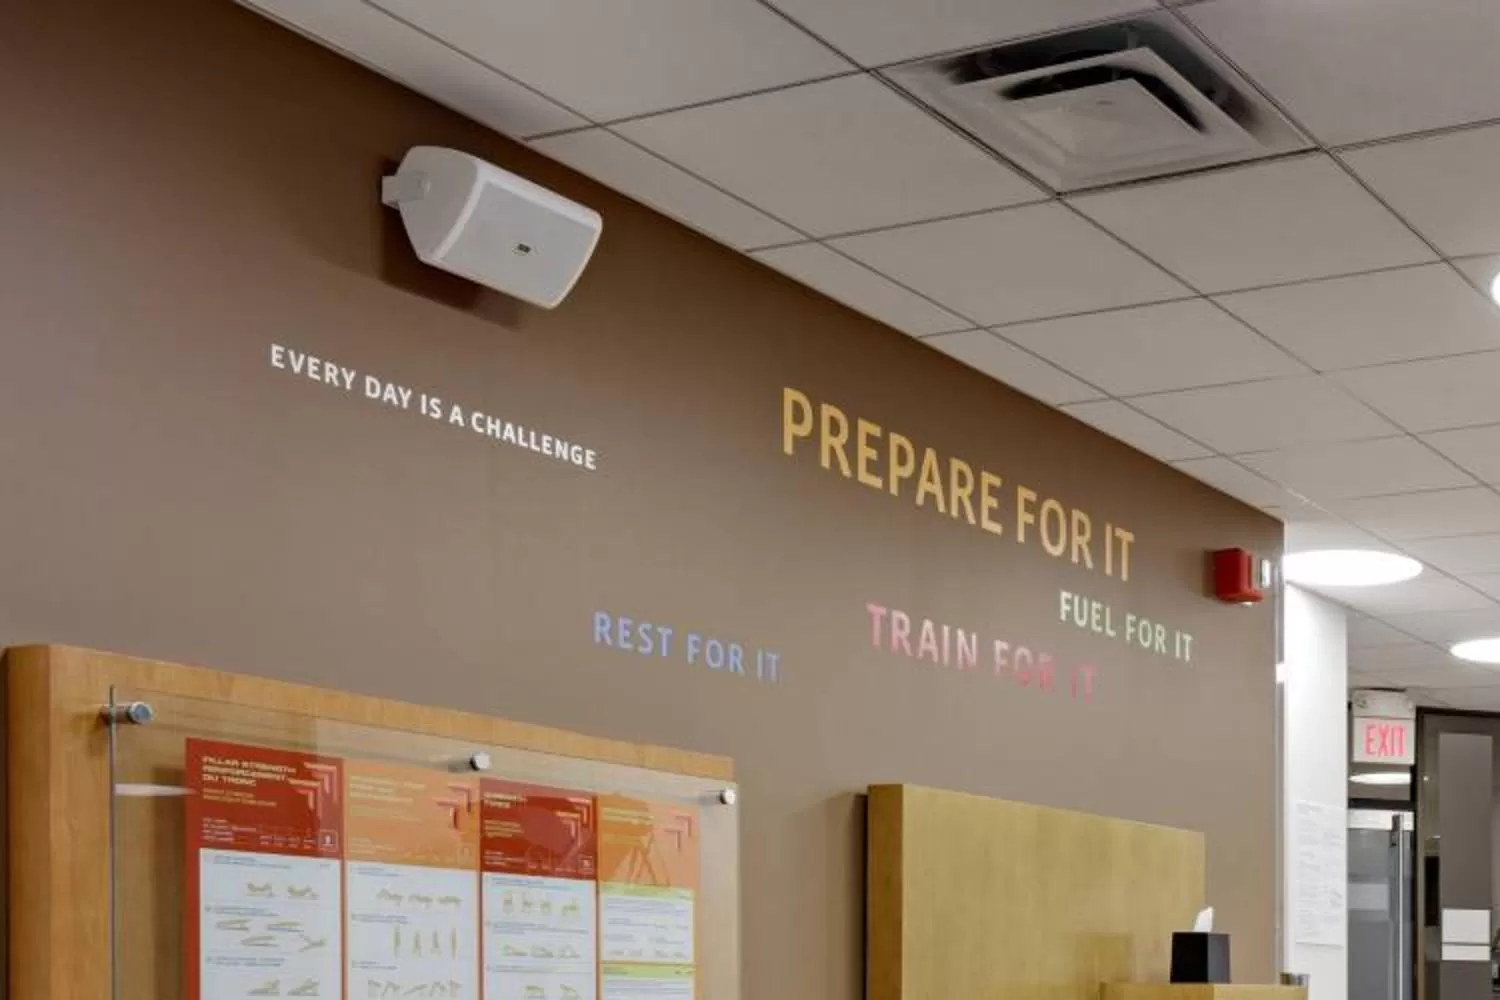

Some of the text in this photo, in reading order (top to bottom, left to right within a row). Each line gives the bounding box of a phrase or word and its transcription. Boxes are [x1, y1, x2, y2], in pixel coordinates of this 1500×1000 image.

[271, 343, 597, 470] EVERY DAY IS A CHALLENGE
[783, 387, 1135, 582] PREPARE FOR IT
[594, 611, 781, 681] REST FOR IT
[866, 604, 1096, 704] TRAIN FOR IT
[1060, 590, 1193, 662] FUEL FOR IT
[1365, 724, 1407, 757] EXIT
